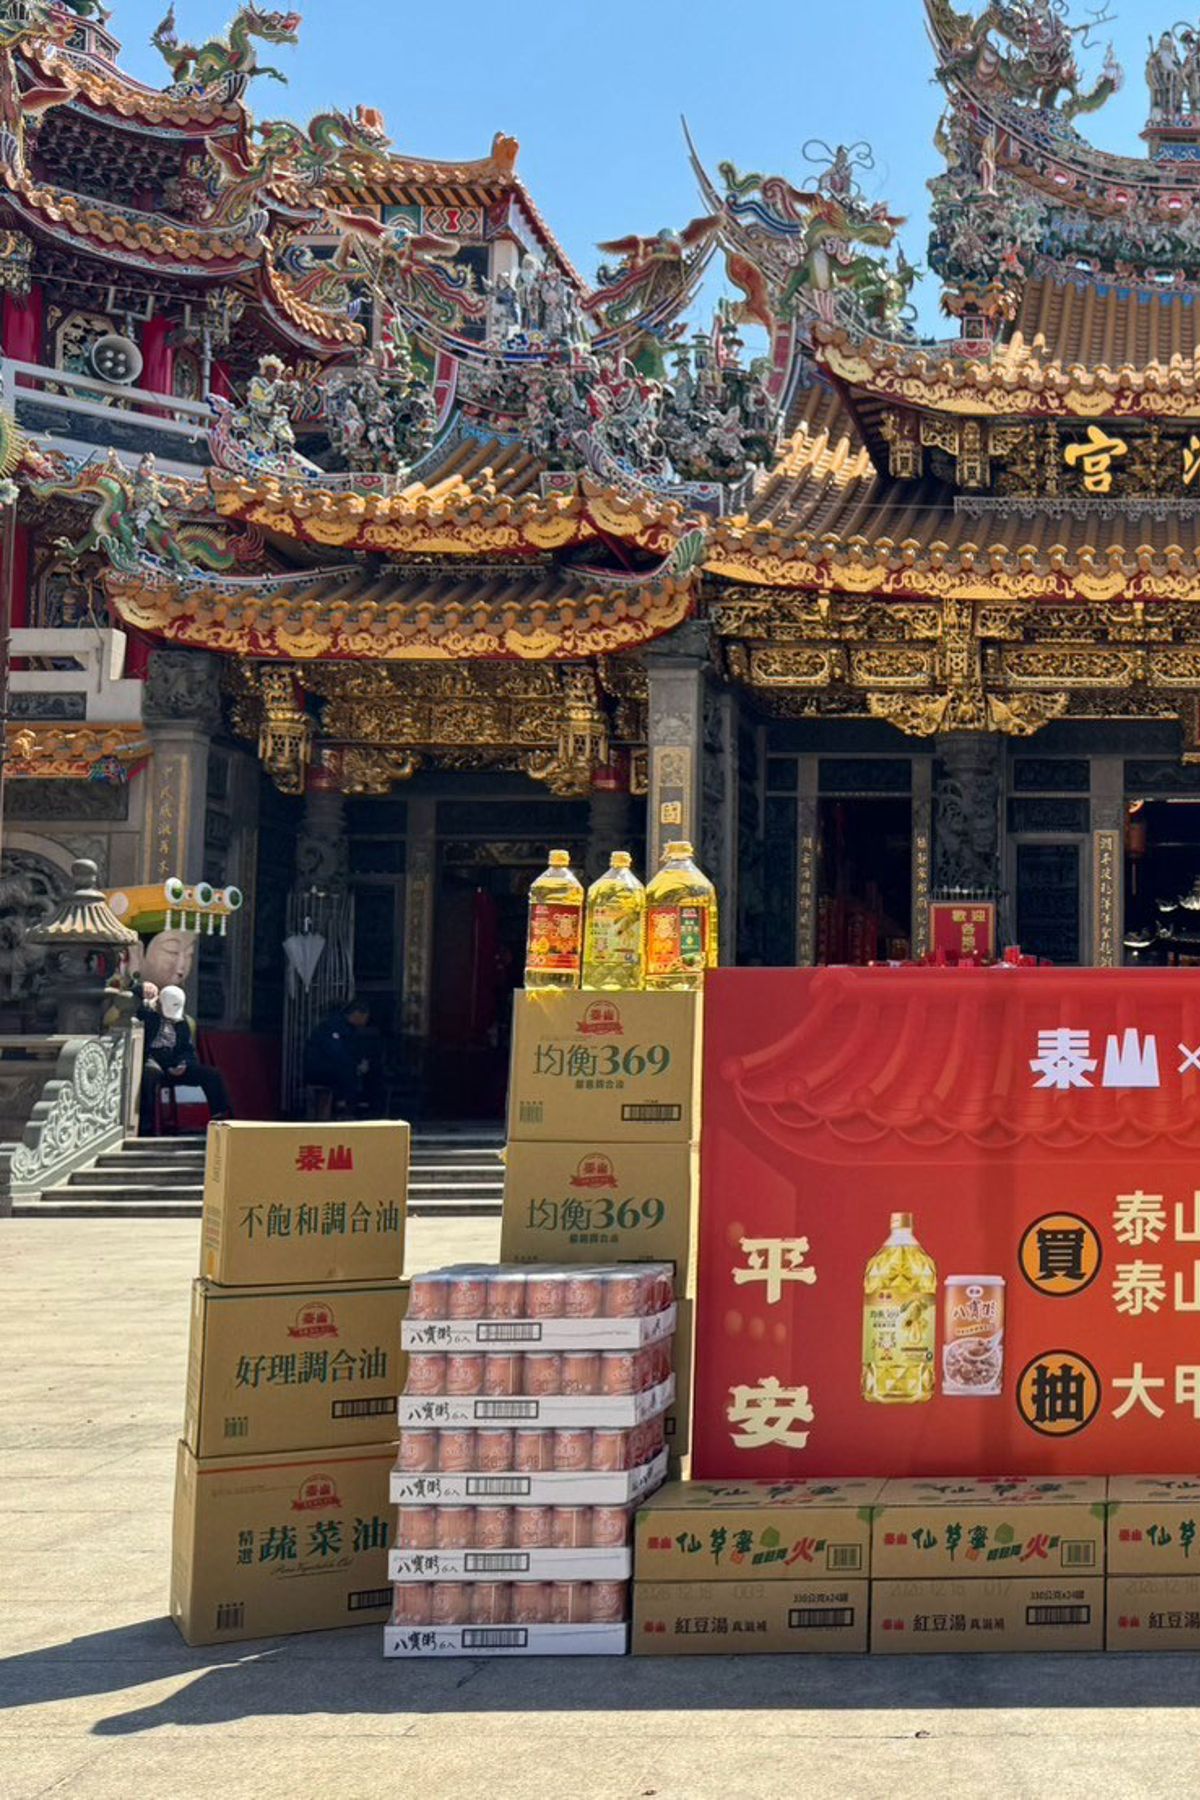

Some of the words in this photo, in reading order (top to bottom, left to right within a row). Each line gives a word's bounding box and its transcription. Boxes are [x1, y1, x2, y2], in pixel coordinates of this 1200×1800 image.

[532, 1044, 671, 1077] 均衡369
[1029, 1027, 1161, 1088] 泰山
[295, 1144, 354, 1171] 泰山
[238, 1200, 400, 1239] 不飽和調合油
[526, 1197, 666, 1231] 均衡369
[1035, 1228, 1087, 1281] 買
[728, 1236, 817, 1449] 平安
[235, 1346, 388, 1389] 好理調合油
[1031, 1363, 1086, 1424] 抽
[259, 1515, 389, 1564] 蔬菜油
